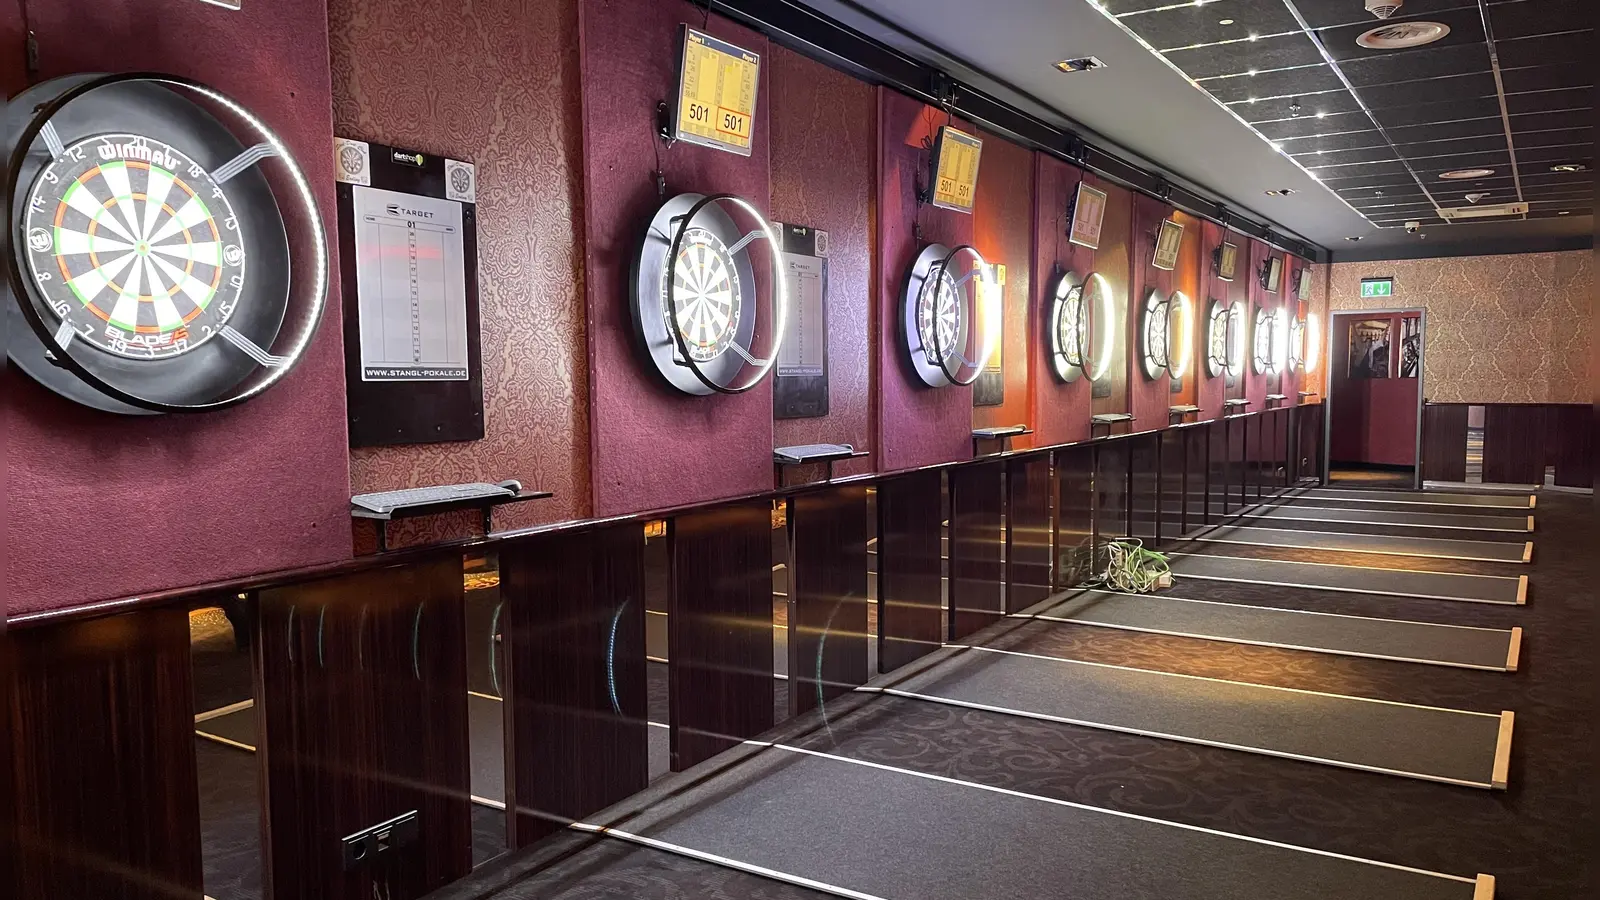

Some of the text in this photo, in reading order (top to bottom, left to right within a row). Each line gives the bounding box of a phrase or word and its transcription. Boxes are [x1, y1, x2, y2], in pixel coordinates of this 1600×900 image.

[690, 103, 742, 133] 501 501
[67, 145, 86, 162] 12
[44, 169, 59, 184] 9
[187, 161, 203, 178] 18
[941, 179, 969, 198] 501 501
[31, 195, 46, 213] 14
[401, 207, 434, 219] TARGET
[407, 220, 416, 229] 01
[37, 271, 52, 282] 8
[201, 325, 213, 337] 2
[366, 369, 466, 377] WWW.STANGL-POKALE.DE
